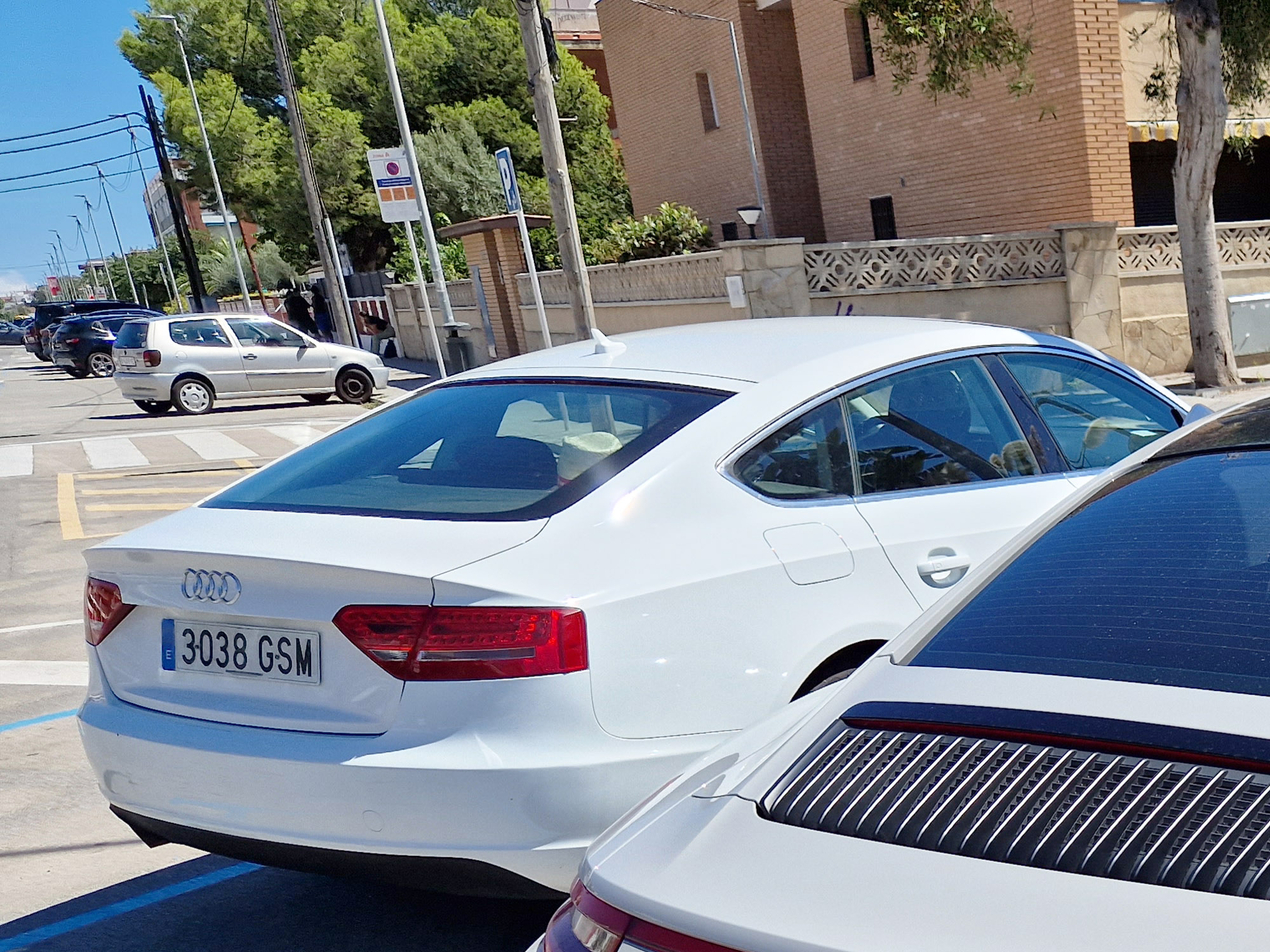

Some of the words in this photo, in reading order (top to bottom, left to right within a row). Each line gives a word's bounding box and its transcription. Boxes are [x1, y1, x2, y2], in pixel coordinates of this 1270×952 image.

[165, 648, 173, 661] E
[181, 628, 248, 670] 3038
[258, 634, 312, 677] GSM
